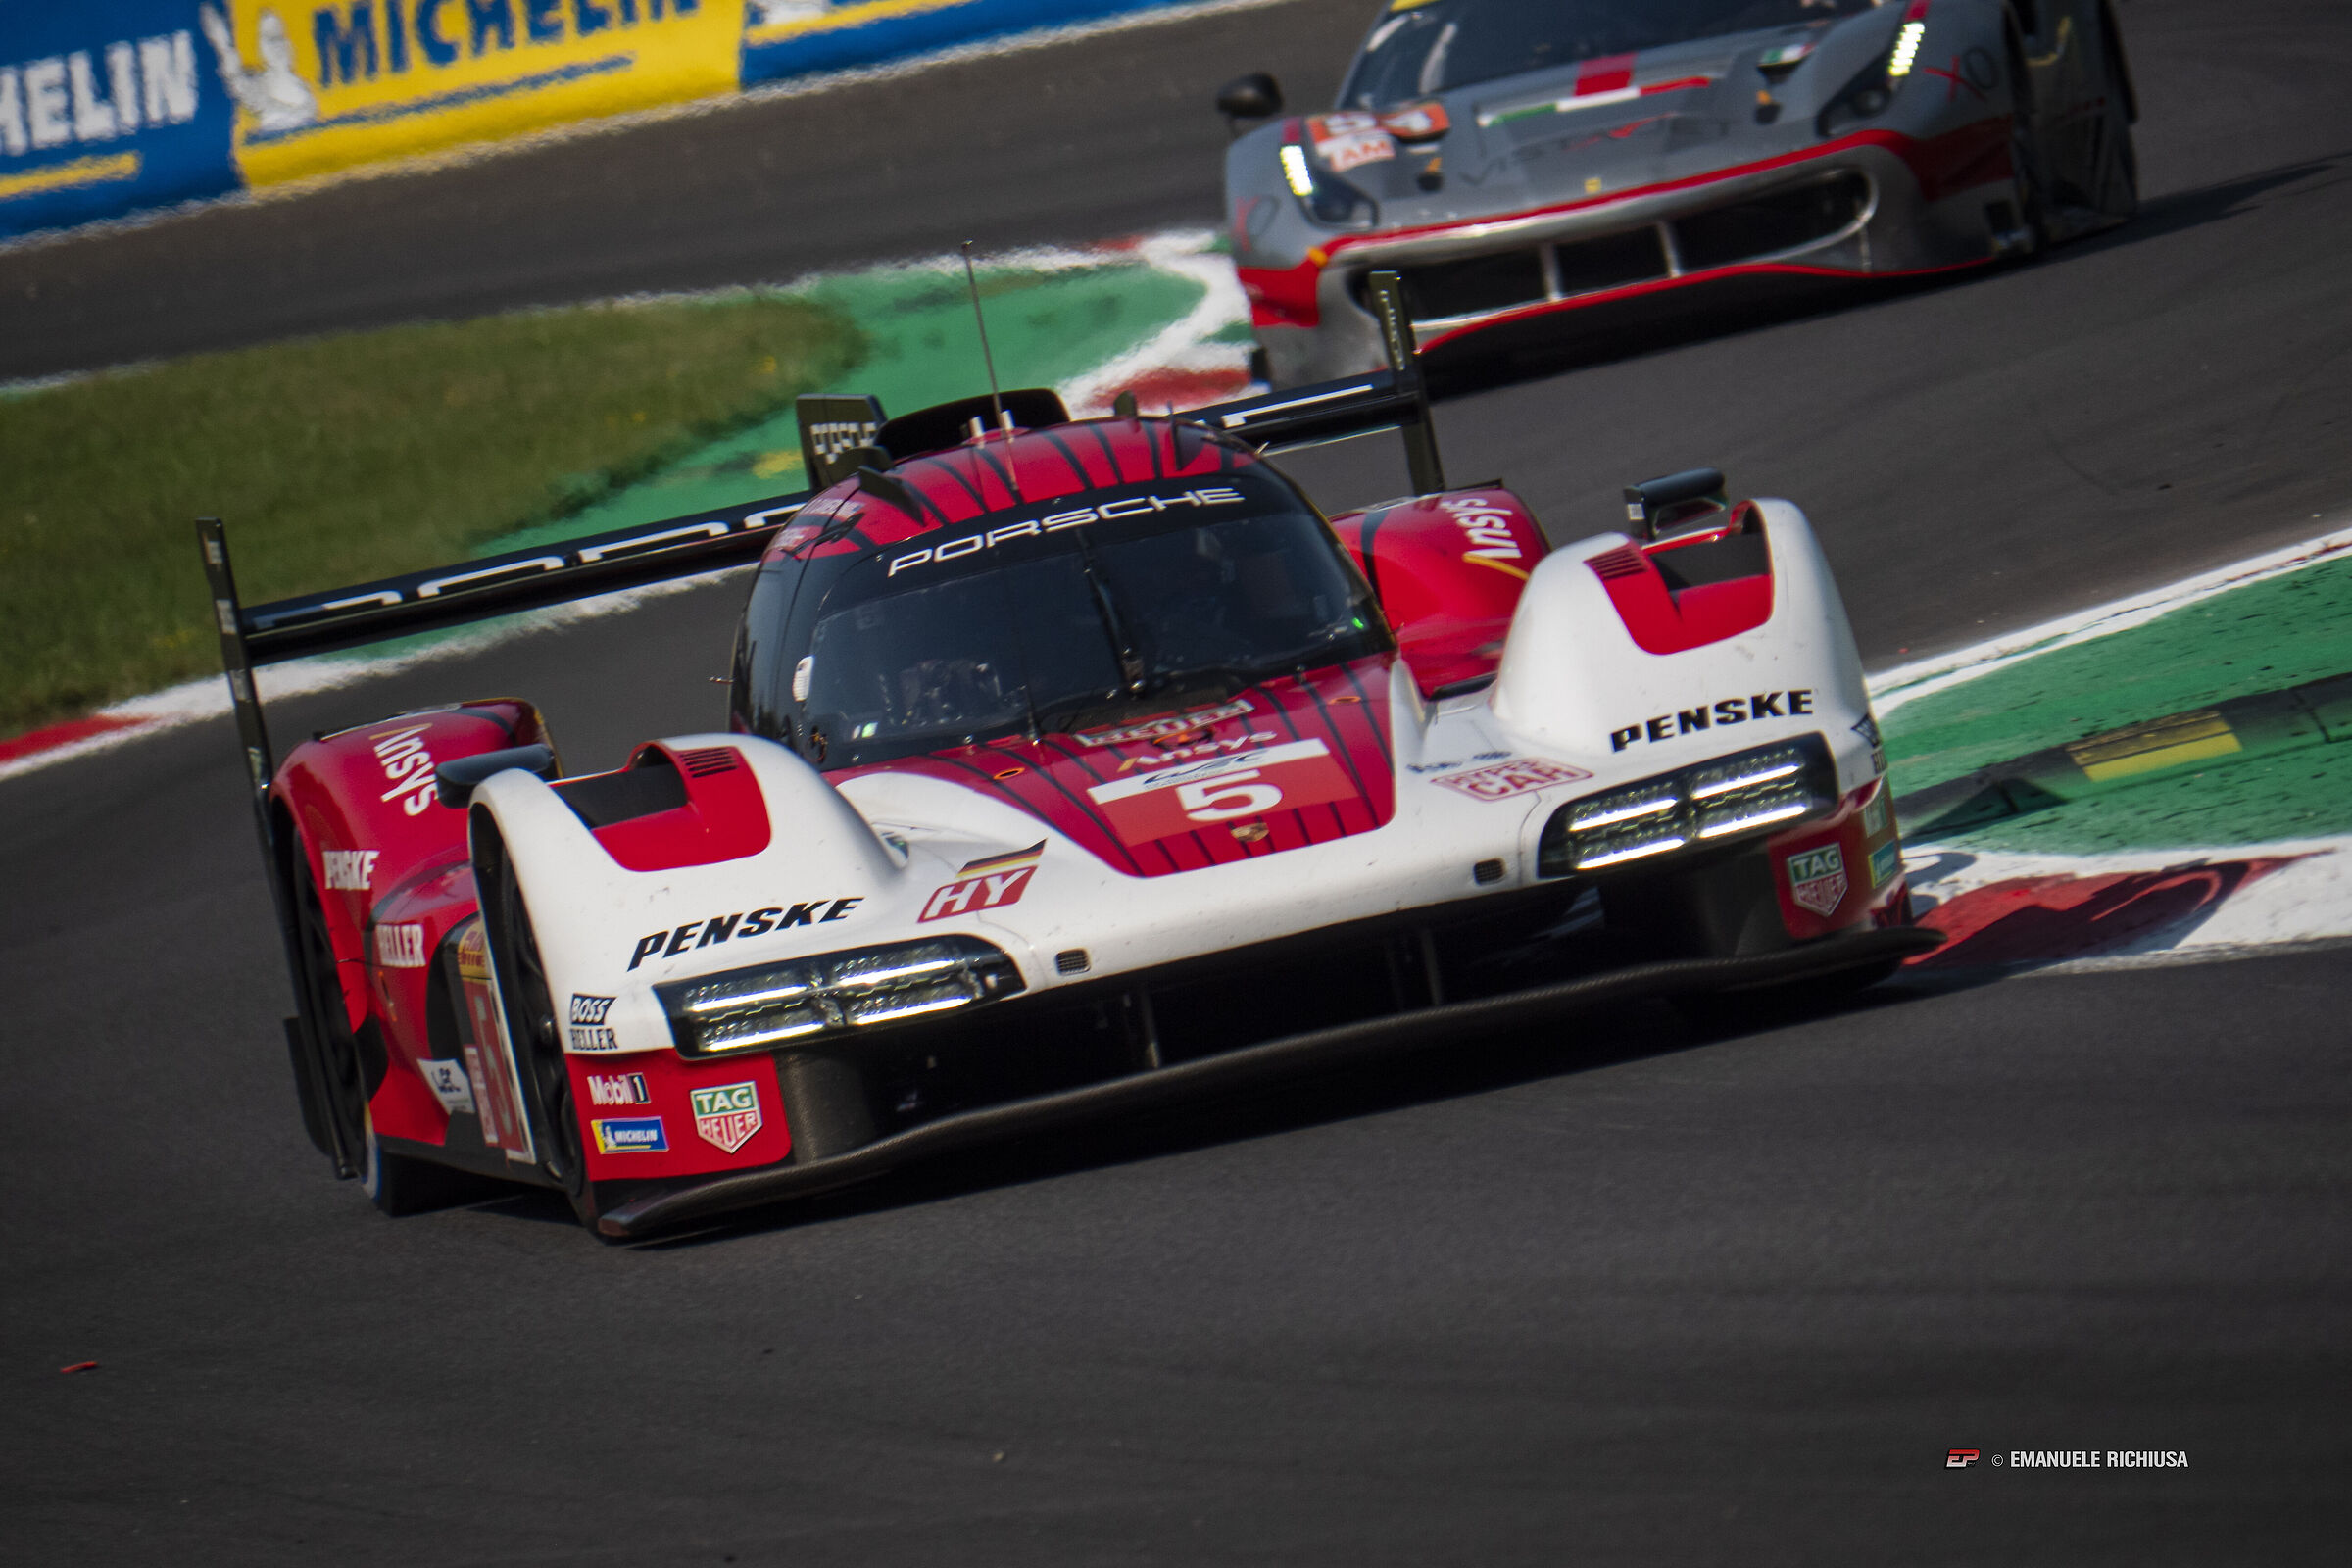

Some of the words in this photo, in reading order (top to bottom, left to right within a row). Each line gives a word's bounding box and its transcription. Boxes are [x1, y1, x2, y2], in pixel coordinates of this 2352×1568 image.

[312, 0, 700, 87] MICHE
[887, 486, 1246, 578] PORSCHE
[1609, 688, 1814, 753] PENSKE
[1176, 769, 1284, 821] 5
[1467, 765, 1580, 796] CAR
[1792, 849, 1840, 878] TAG
[922, 869, 1031, 921] HY
[627, 897, 865, 972] PENSKE
[571, 996, 611, 1024] BOSS
[570, 1027, 619, 1051] HELLER
[587, 1074, 633, 1106] Mobil
[696, 1088, 753, 1115] TAG
[613, 1128, 659, 1144] MICHELIN
[697, 1109, 758, 1148] HEUER
